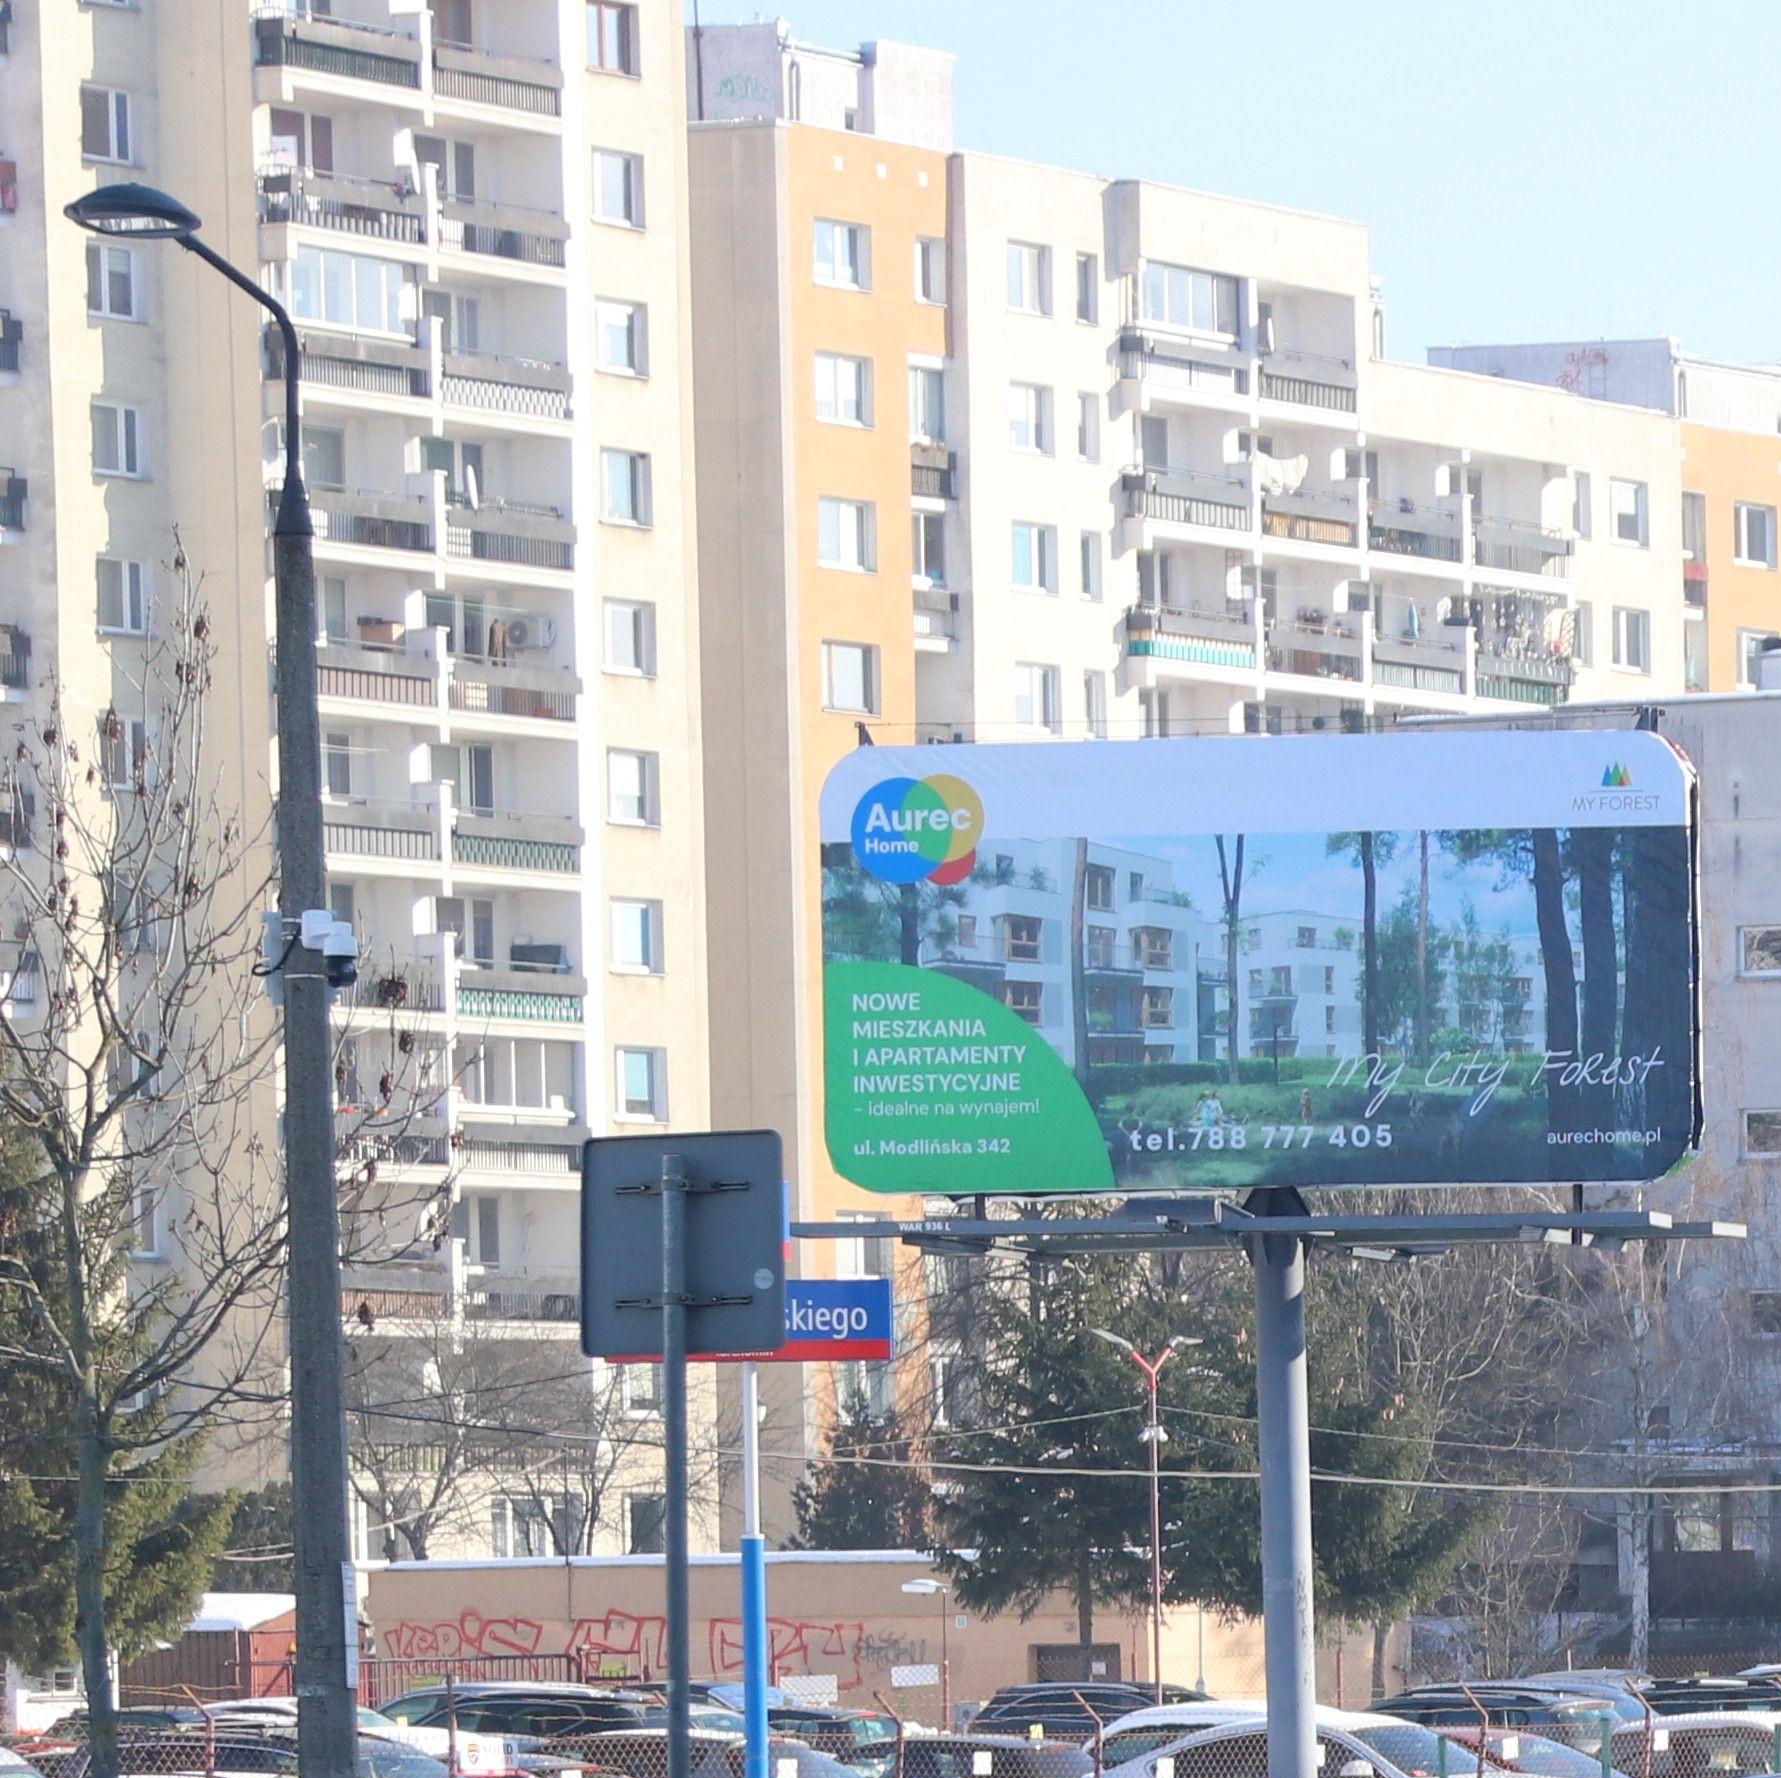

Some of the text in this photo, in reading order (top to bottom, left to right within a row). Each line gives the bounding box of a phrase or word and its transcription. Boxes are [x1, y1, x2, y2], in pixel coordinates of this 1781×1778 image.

[1571, 795, 1661, 811] MY FOREST
[864, 802, 972, 834] Aurec
[864, 838, 920, 854] Home
[852, 992, 921, 1012] NOWE
[853, 1019, 987, 1039] MIESZKANIA
[853, 1045, 1027, 1067] I APARTAMENTY
[853, 1072, 1021, 1094] INWESTYCYJNE
[1326, 1052, 1406, 1119] My
[1424, 1049, 1511, 1118] City
[868, 1100, 929, 1116] idealne
[934, 1103, 955, 1115] na
[959, 1098, 1041, 1119] wynajem!
[854, 1137, 1011, 1156] ul. Modlińska 342
[1260, 1125, 1316, 1150] 777
[1328, 1123, 1394, 1149] 405
[1546, 1126, 1662, 1147] aurechome.pl
[898, 1221, 923, 1232] WAR
